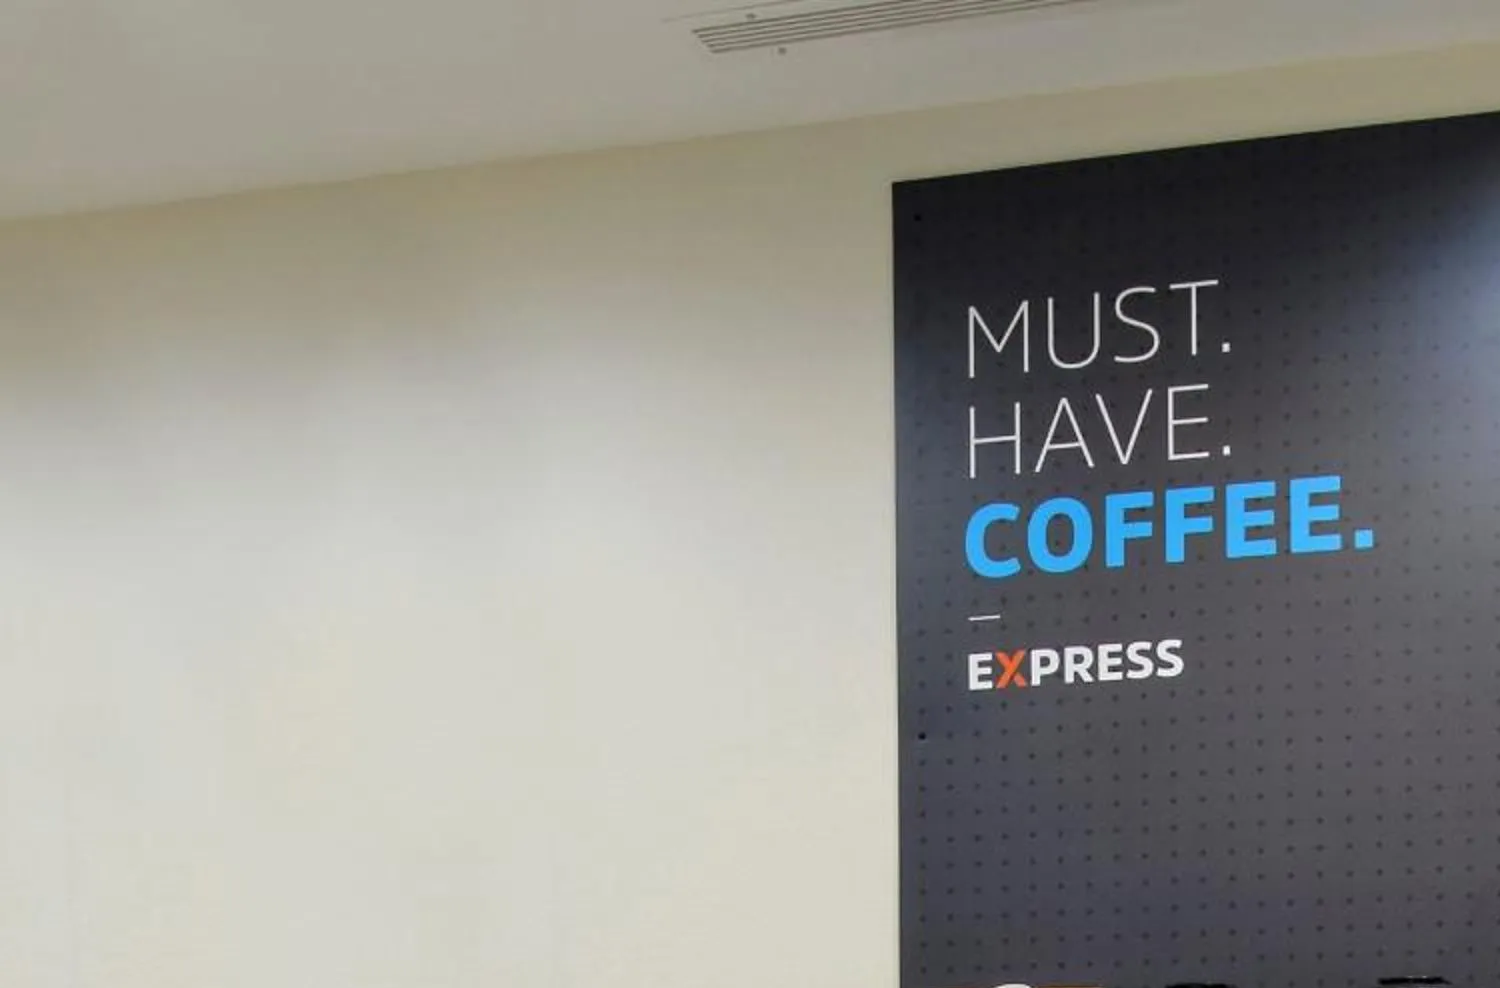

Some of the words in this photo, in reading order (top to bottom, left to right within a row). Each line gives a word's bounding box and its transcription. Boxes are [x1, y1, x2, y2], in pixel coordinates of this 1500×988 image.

[968, 279, 1231, 378] MUST.
[968, 384, 1231, 478] HAVE.
[964, 475, 1374, 578] COFFEE.
[968, 639, 1184, 690] EXPRESS
